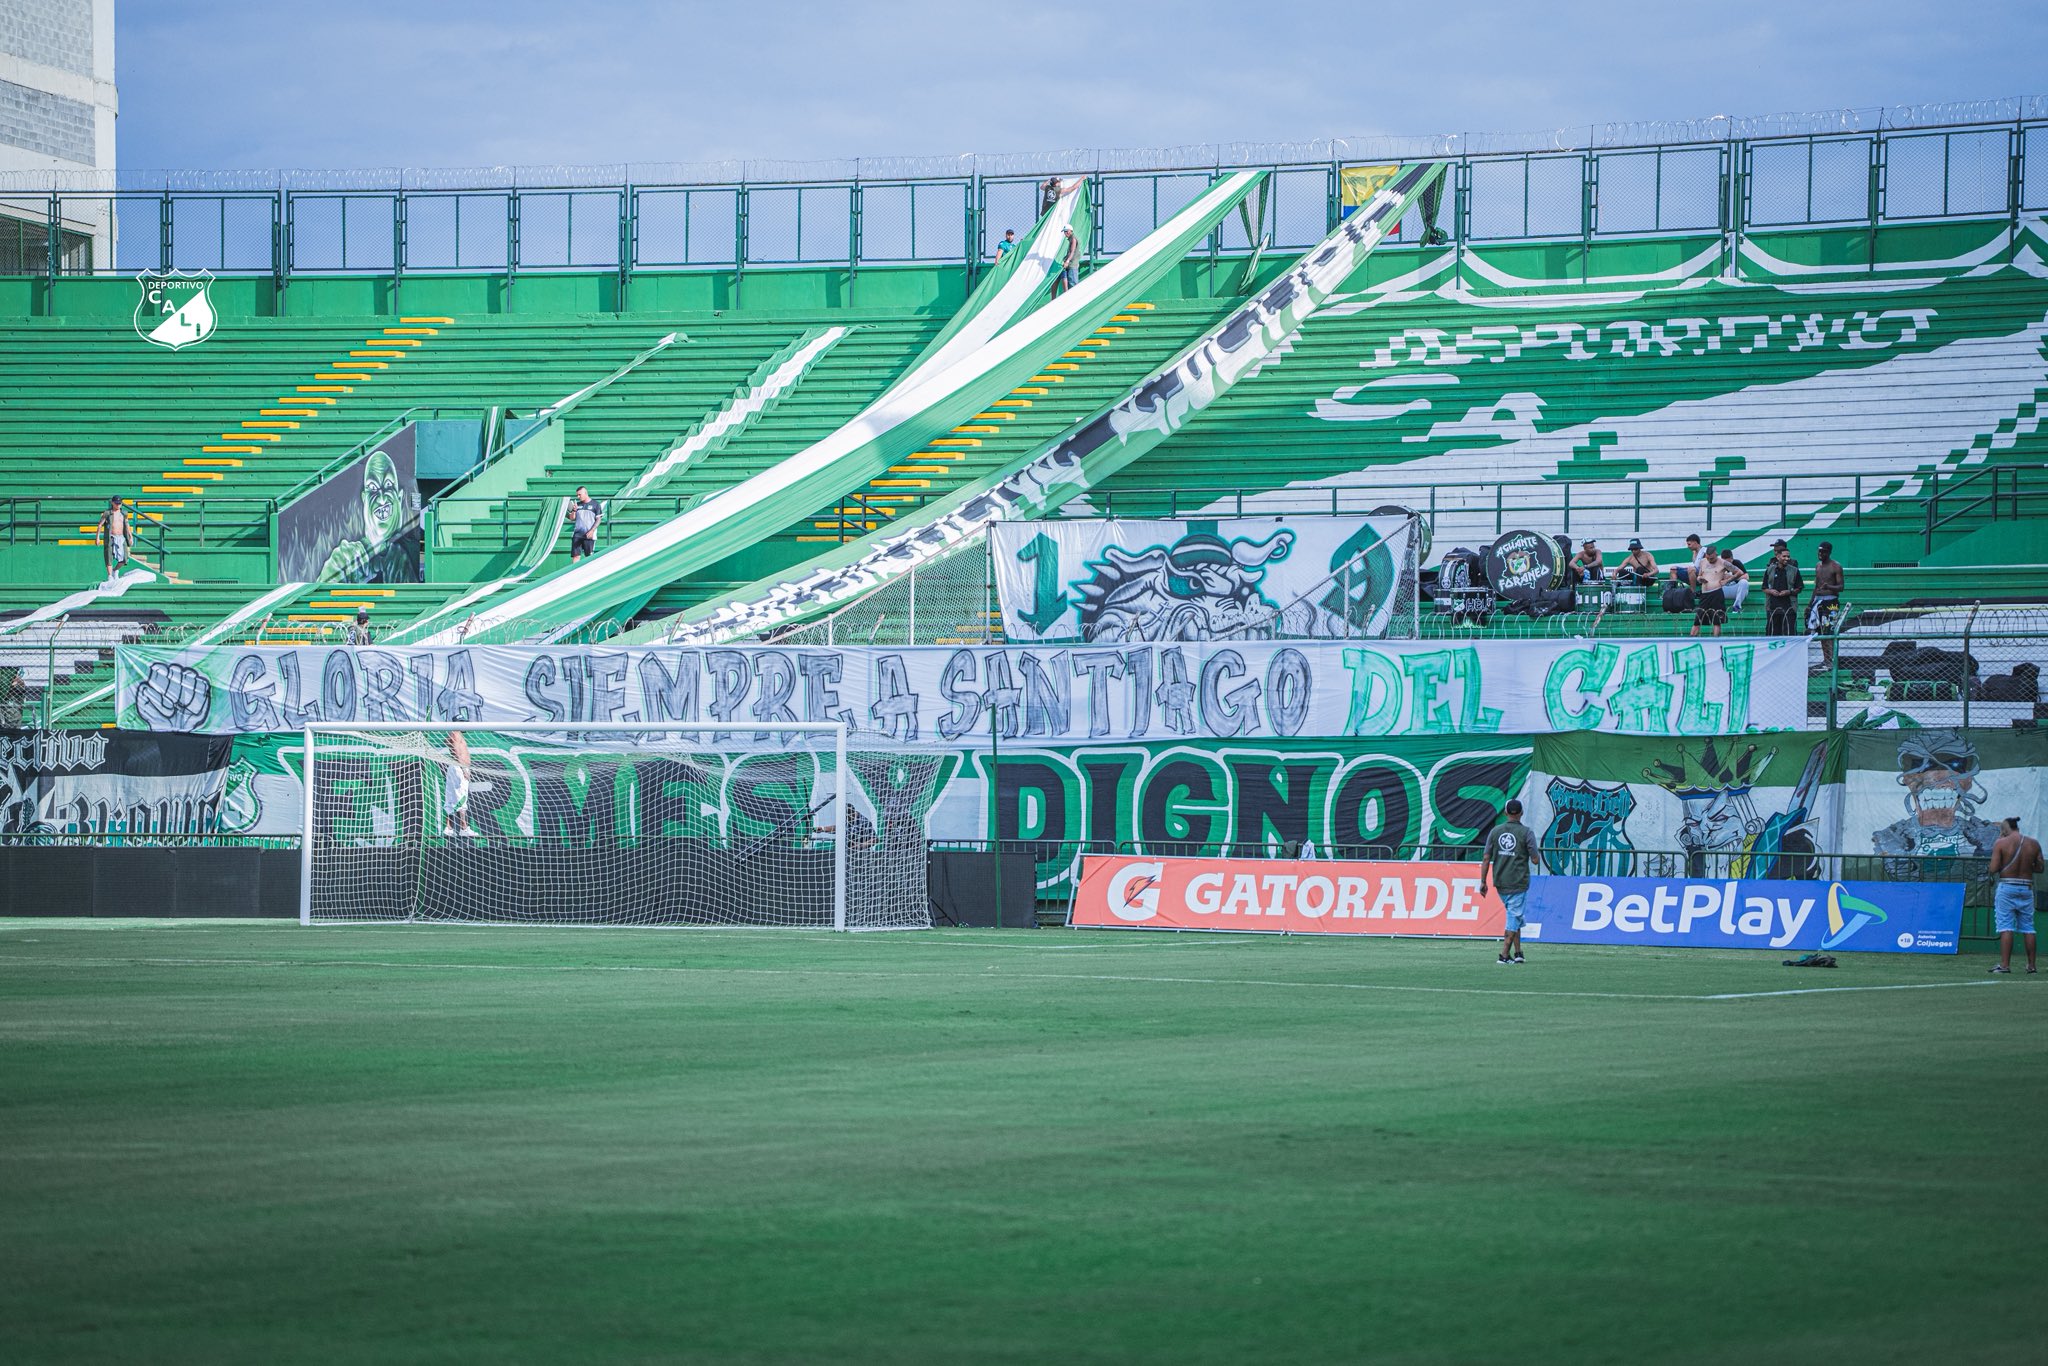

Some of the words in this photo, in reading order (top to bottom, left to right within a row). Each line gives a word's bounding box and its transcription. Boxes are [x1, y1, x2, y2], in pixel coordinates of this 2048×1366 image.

[1358, 308, 1940, 369] DEPORTIVO
[1496, 536, 1539, 558] AGUANTE
[1498, 564, 1550, 592] FORANEO
[229, 648, 485, 733] GLORIA
[523, 650, 857, 746] SIEMPRE
[871, 653, 919, 743] A
[937, 645, 1313, 739] SANTIAGO
[1342, 646, 1505, 737] DEL
[1543, 643, 1756, 736] CALI
[980, 754, 1522, 864] DIGNOS
[1185, 871, 1481, 923] GATORADE
[1571, 880, 1817, 948] BetPlay
